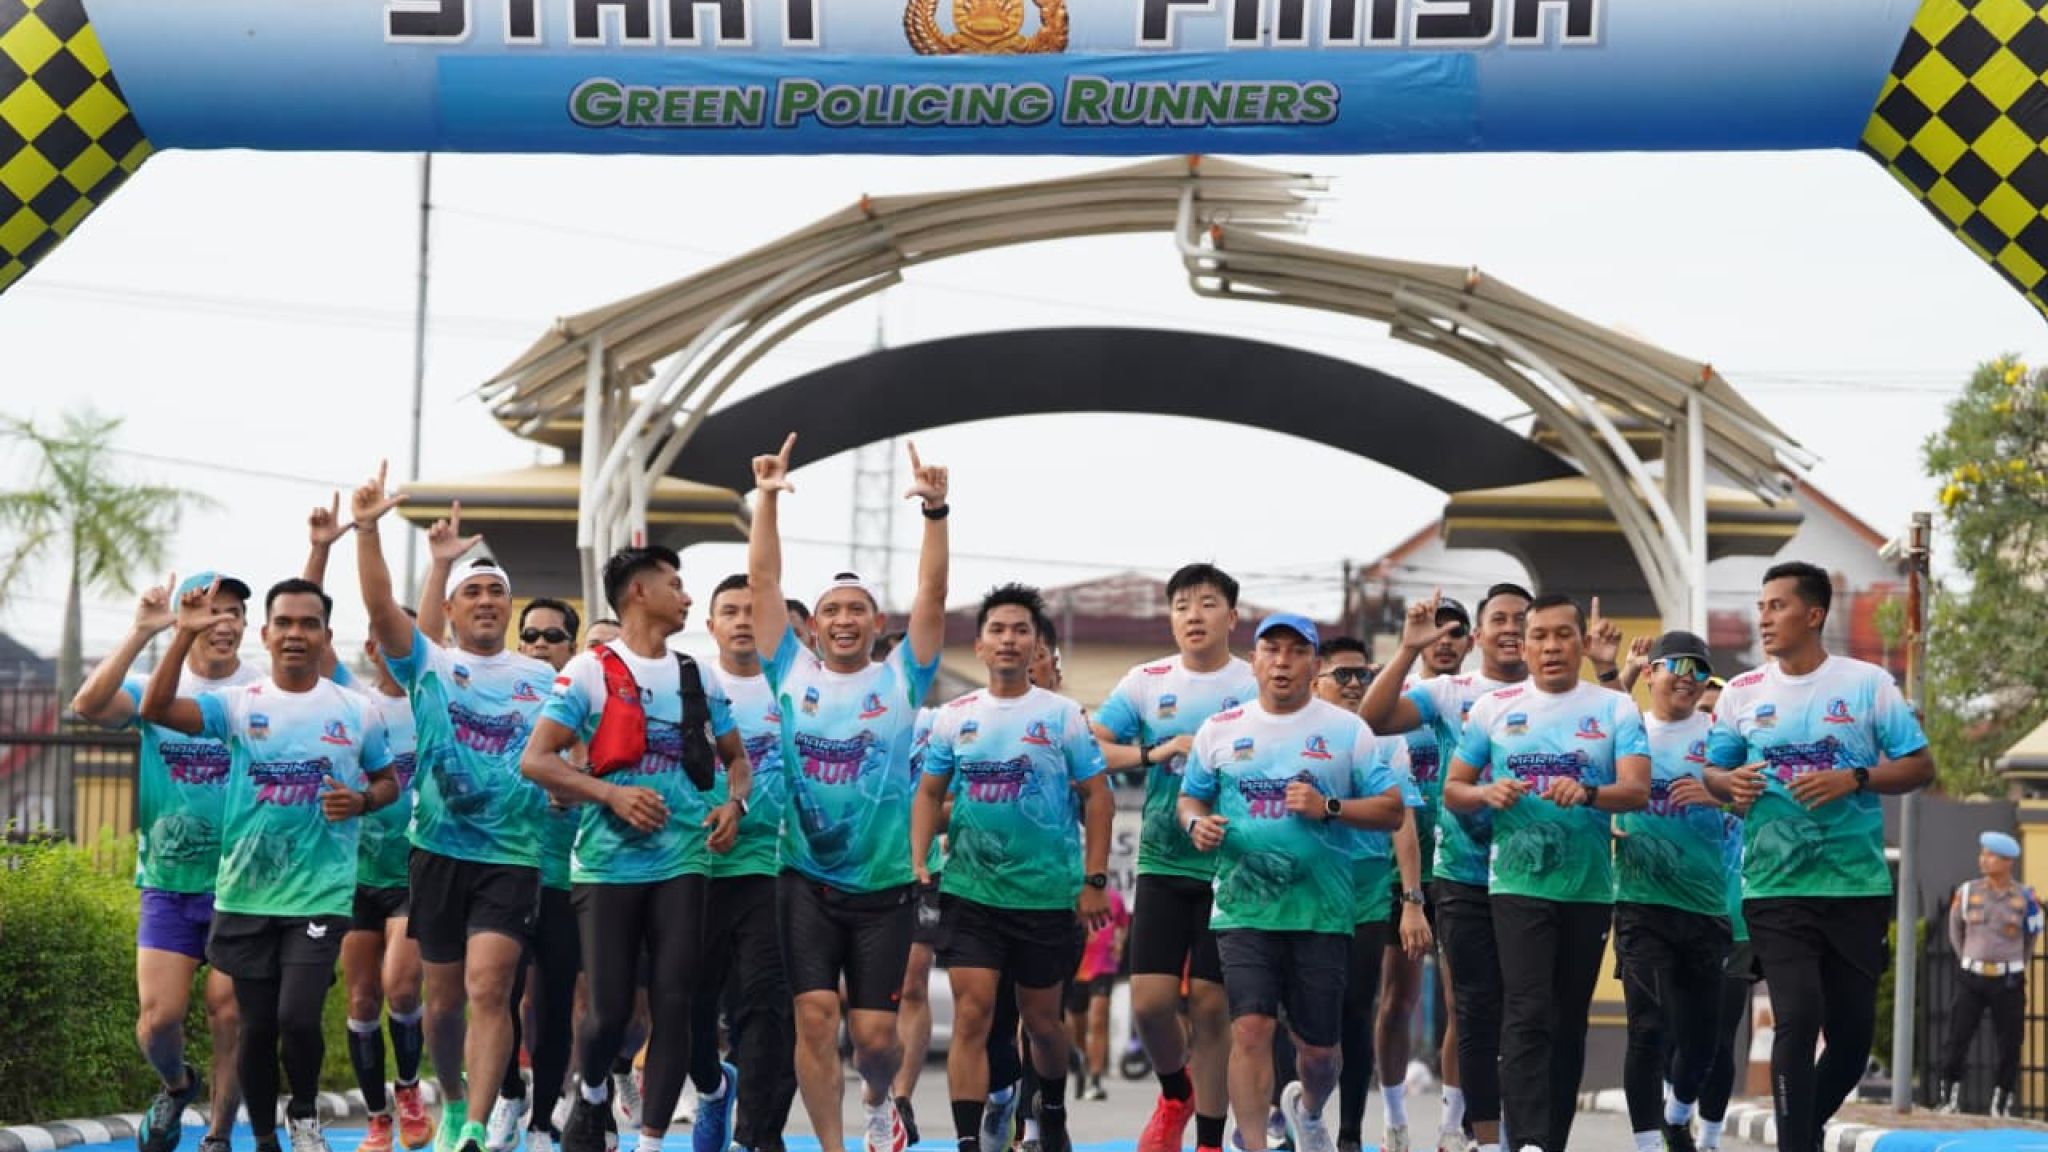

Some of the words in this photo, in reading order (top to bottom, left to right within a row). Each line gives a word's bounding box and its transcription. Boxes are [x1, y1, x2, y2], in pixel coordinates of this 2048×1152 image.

[570, 77, 767, 128] GREEN
[774, 78, 1053, 127] POLICING
[1063, 75, 1339, 126] RUNNERS
